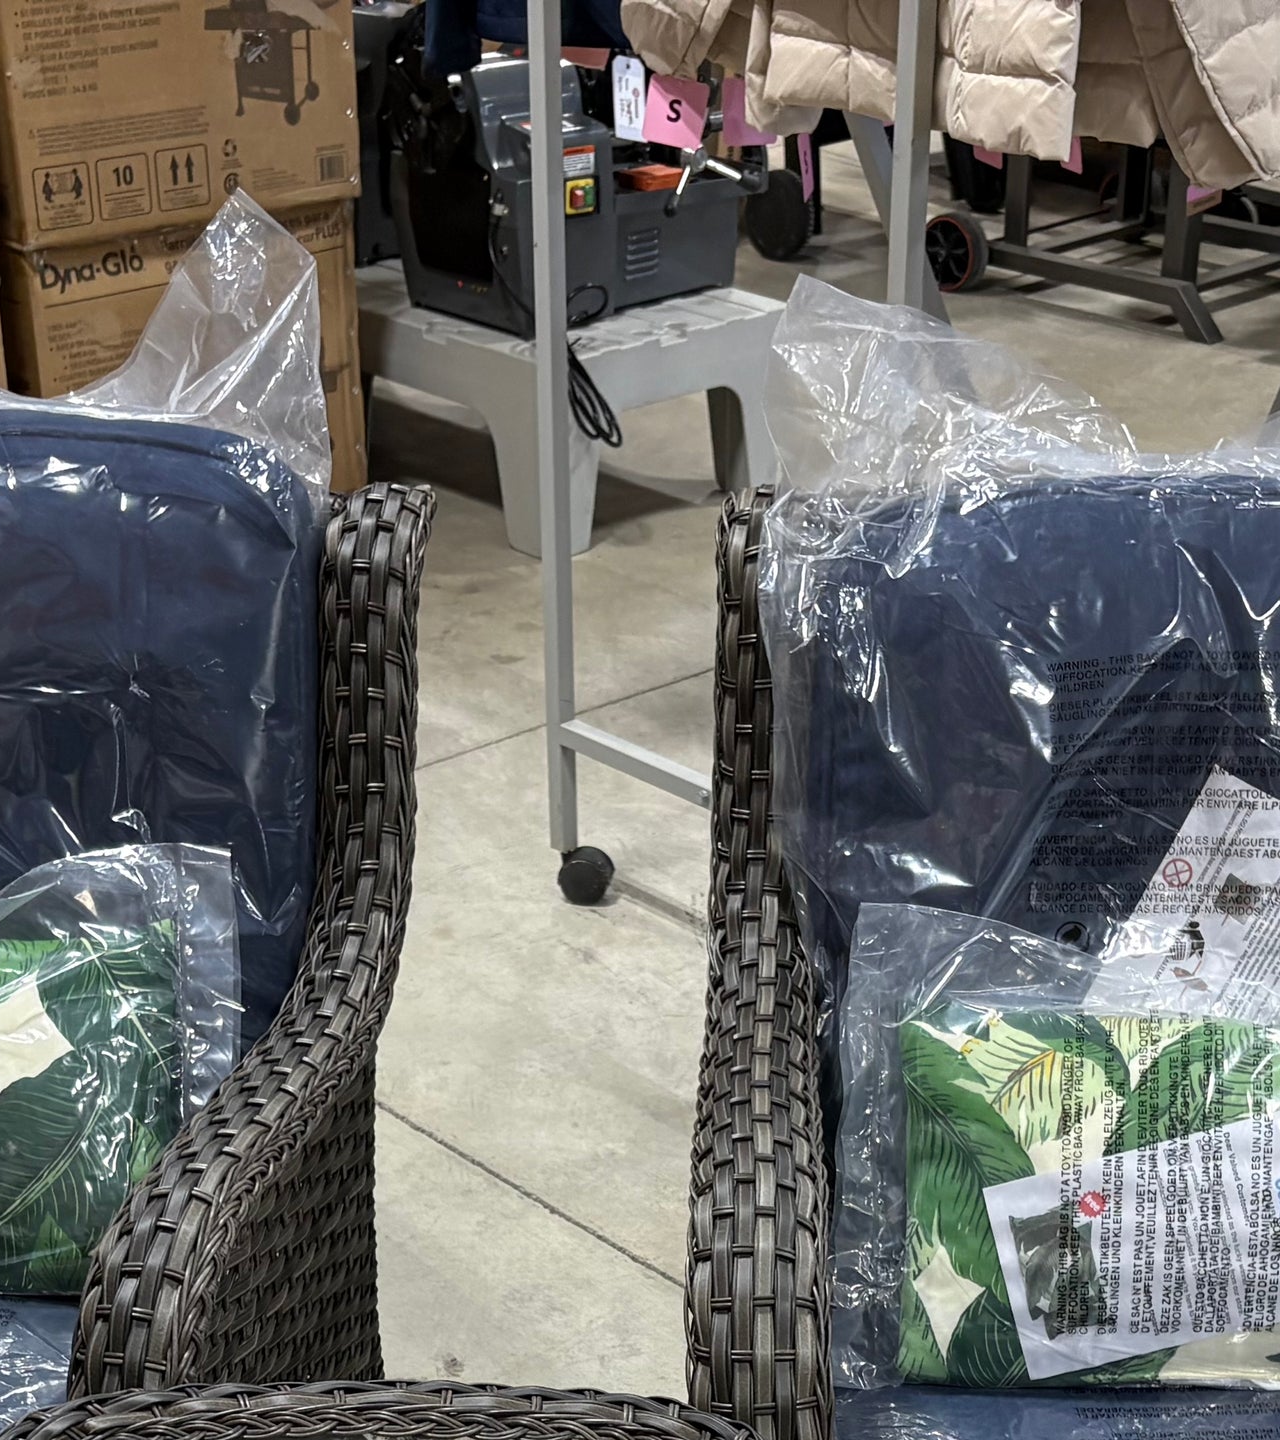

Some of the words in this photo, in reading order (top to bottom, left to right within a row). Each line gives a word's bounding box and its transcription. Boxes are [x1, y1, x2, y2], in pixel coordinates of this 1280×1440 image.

[666, 99, 682, 123] S
[112, 165, 133, 187] 10
[1046, 658, 1100, 672] WARNING
[1073, 1126, 1083, 1148] BAG
[1252, 1138, 1261, 1152] UN
[1072, 1150, 1082, 1197] PLASTIC
[1060, 1189, 1069, 1211] NOT
[1059, 1226, 1069, 1249] BAG
[1134, 1222, 1144, 1237] UN
[1111, 1241, 1121, 1264] UND
[1134, 1240, 1143, 1260] PAS
[1164, 1241, 1174, 1270] GEEN
[1058, 1252, 1068, 1275] THIS
[1161, 1285, 1172, 1305] ZAK
